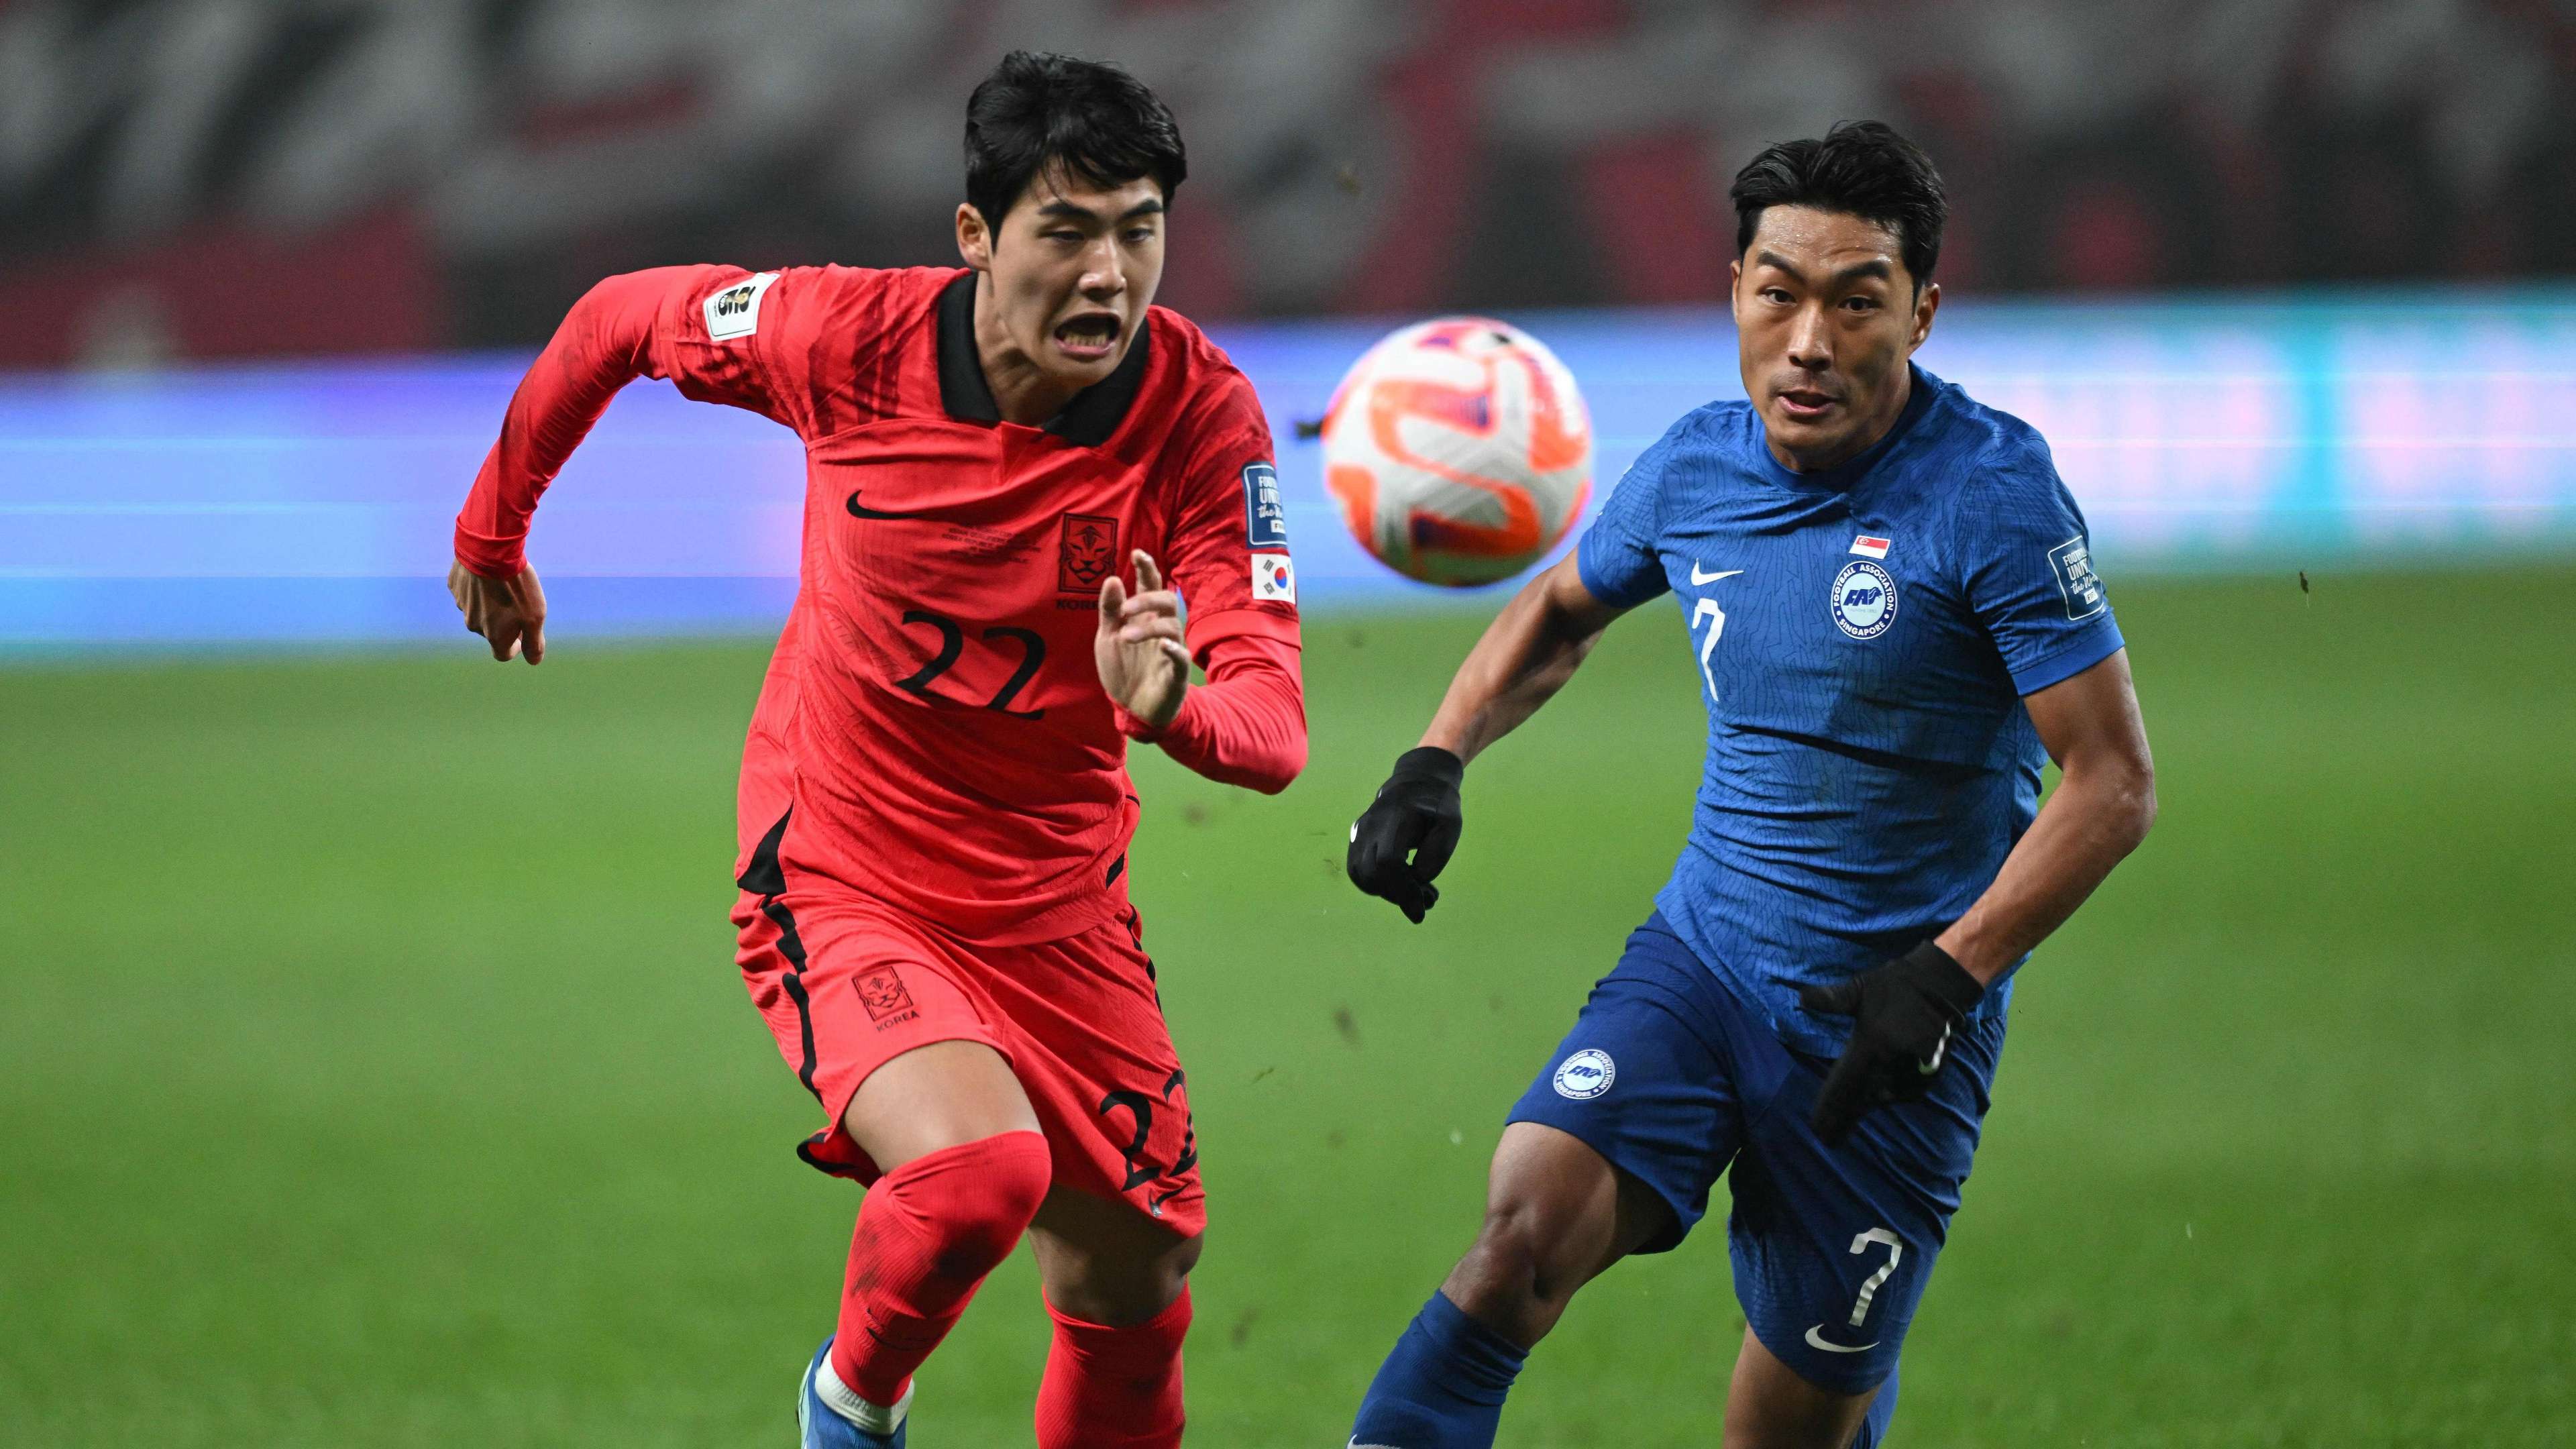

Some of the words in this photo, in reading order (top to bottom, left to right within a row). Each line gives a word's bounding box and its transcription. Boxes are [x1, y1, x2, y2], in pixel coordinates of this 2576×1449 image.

[1056, 598, 1099, 611] KORE
[1833, 566, 1856, 607] FOOTBALL
[1860, 564, 1894, 611] ASSOCIATION
[1692, 598, 1725, 702] 7
[1839, 619, 1886, 636] SINGAPORE
[894, 610, 1046, 720] 22
[876, 1010, 921, 1032] KOREA
[1848, 1227, 1903, 1327] 7
